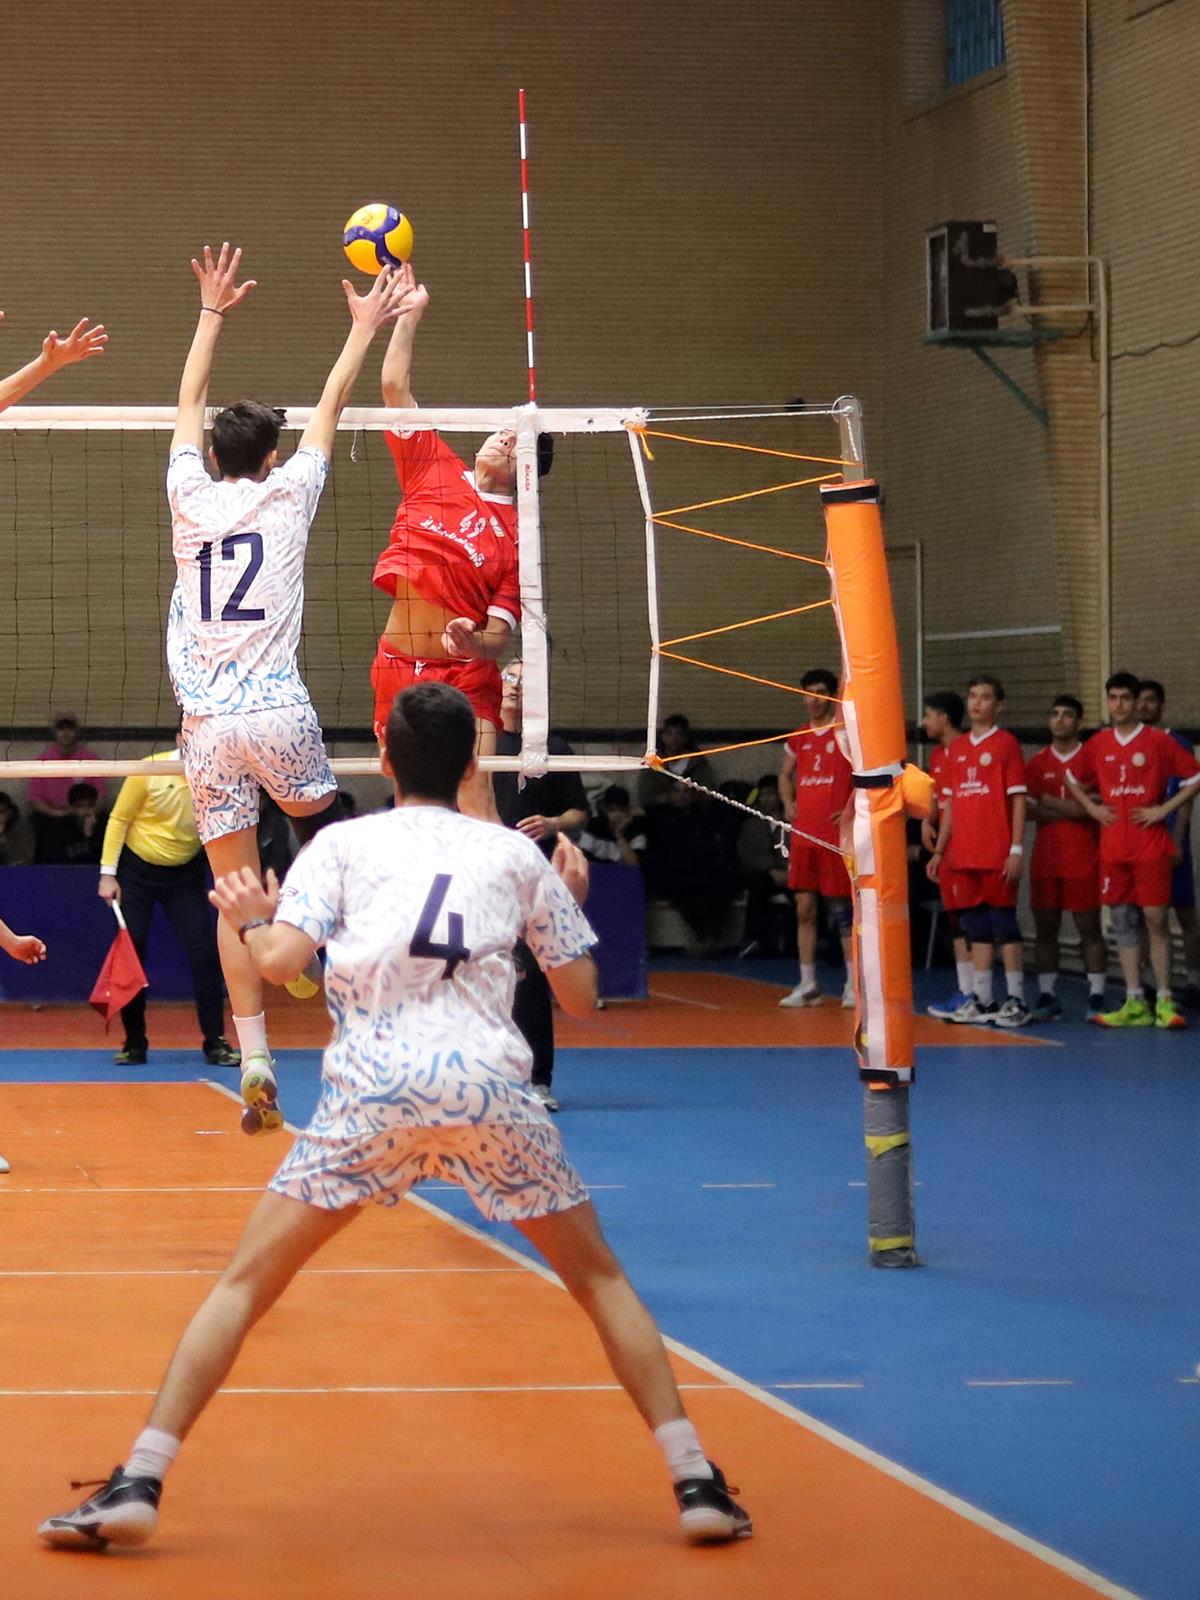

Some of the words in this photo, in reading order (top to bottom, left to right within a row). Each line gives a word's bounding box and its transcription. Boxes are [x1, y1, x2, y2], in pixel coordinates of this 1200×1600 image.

[460, 509, 487, 538] 49
[195, 532, 265, 621] 12
[813, 754, 821, 771] 2
[409, 873, 471, 981] 4
